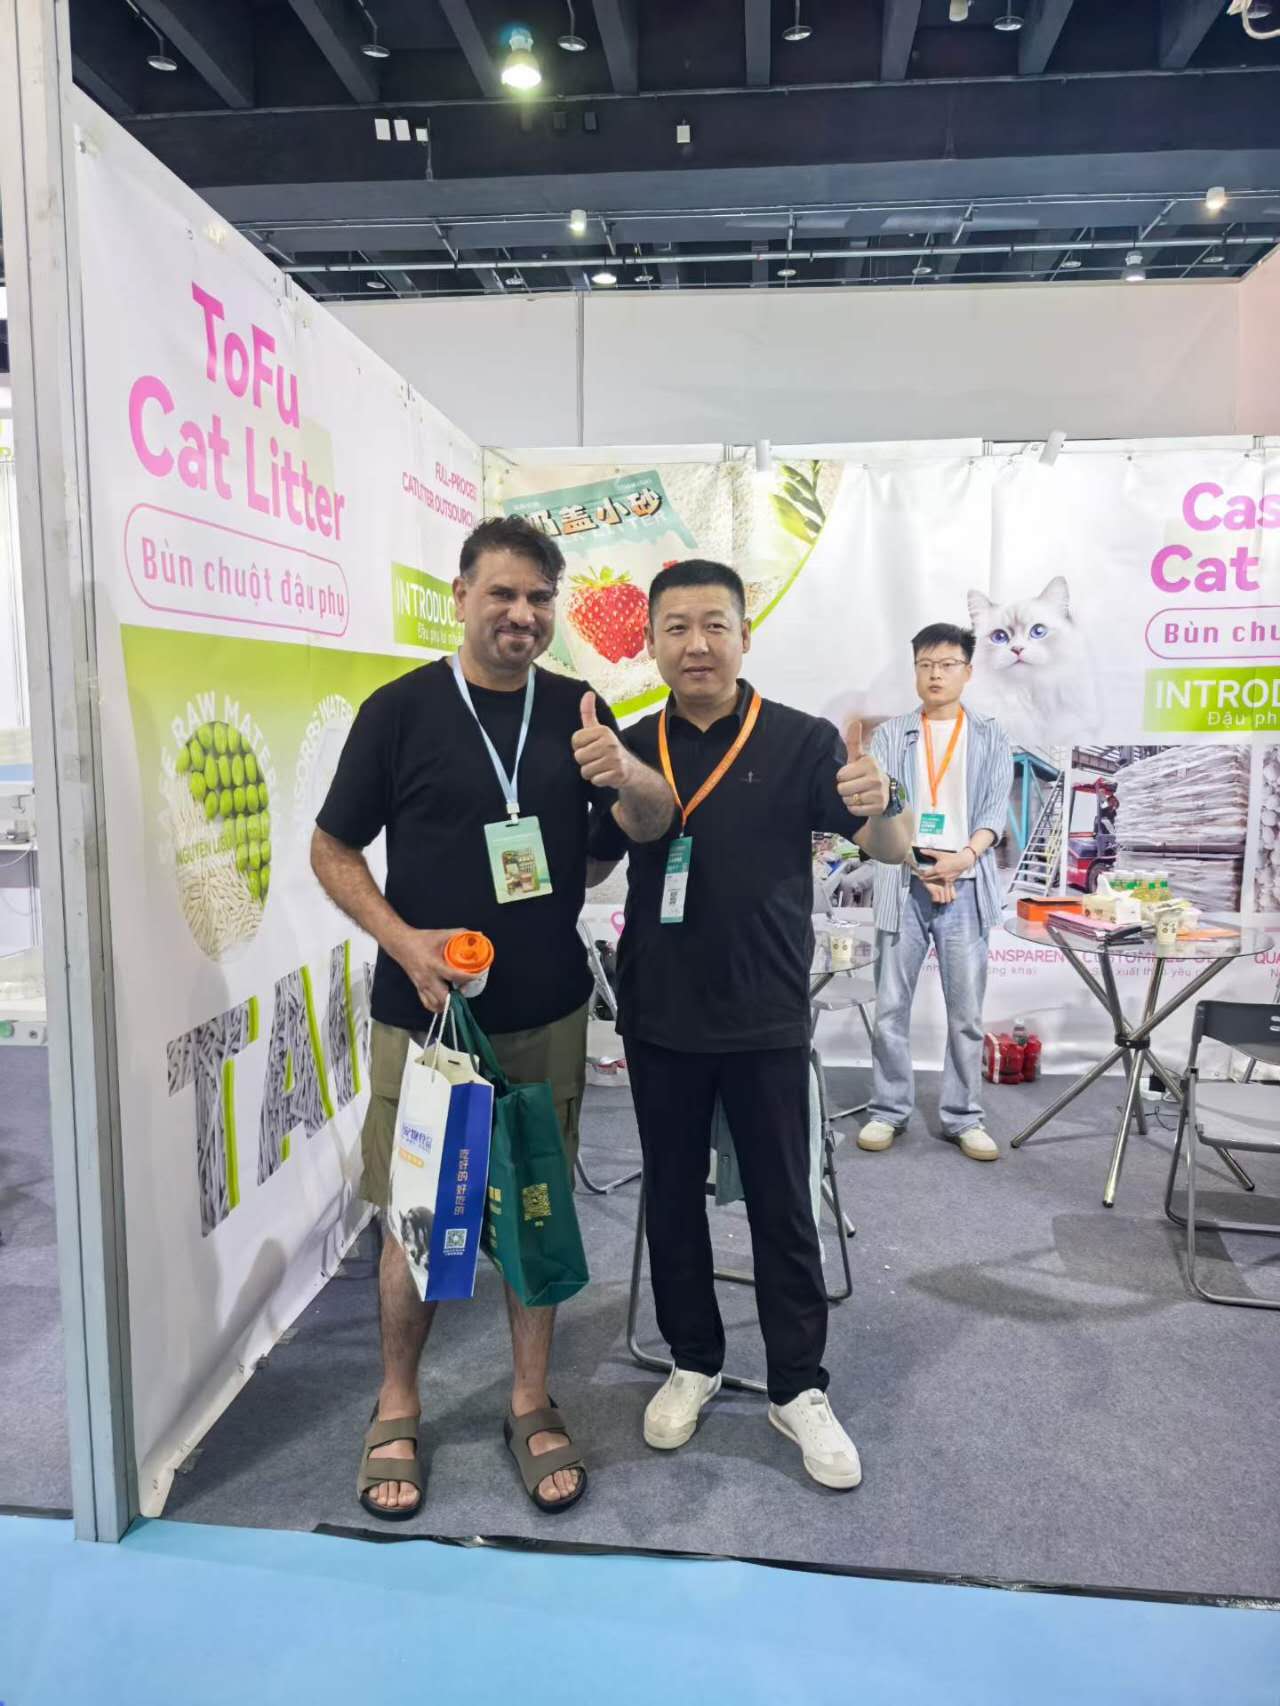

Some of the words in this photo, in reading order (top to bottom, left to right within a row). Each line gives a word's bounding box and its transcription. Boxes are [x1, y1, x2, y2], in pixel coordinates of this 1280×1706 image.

[191, 281, 300, 429] ToFu
[128, 375, 233, 500] Cat
[245, 426, 345, 541] Litter
[1182, 482, 1280, 531] Cas
[142, 536, 193, 588] Bùn
[204, 557, 273, 606] chuột
[1150, 544, 1260, 593] Cat
[1164, 621, 1219, 644] Bùn
